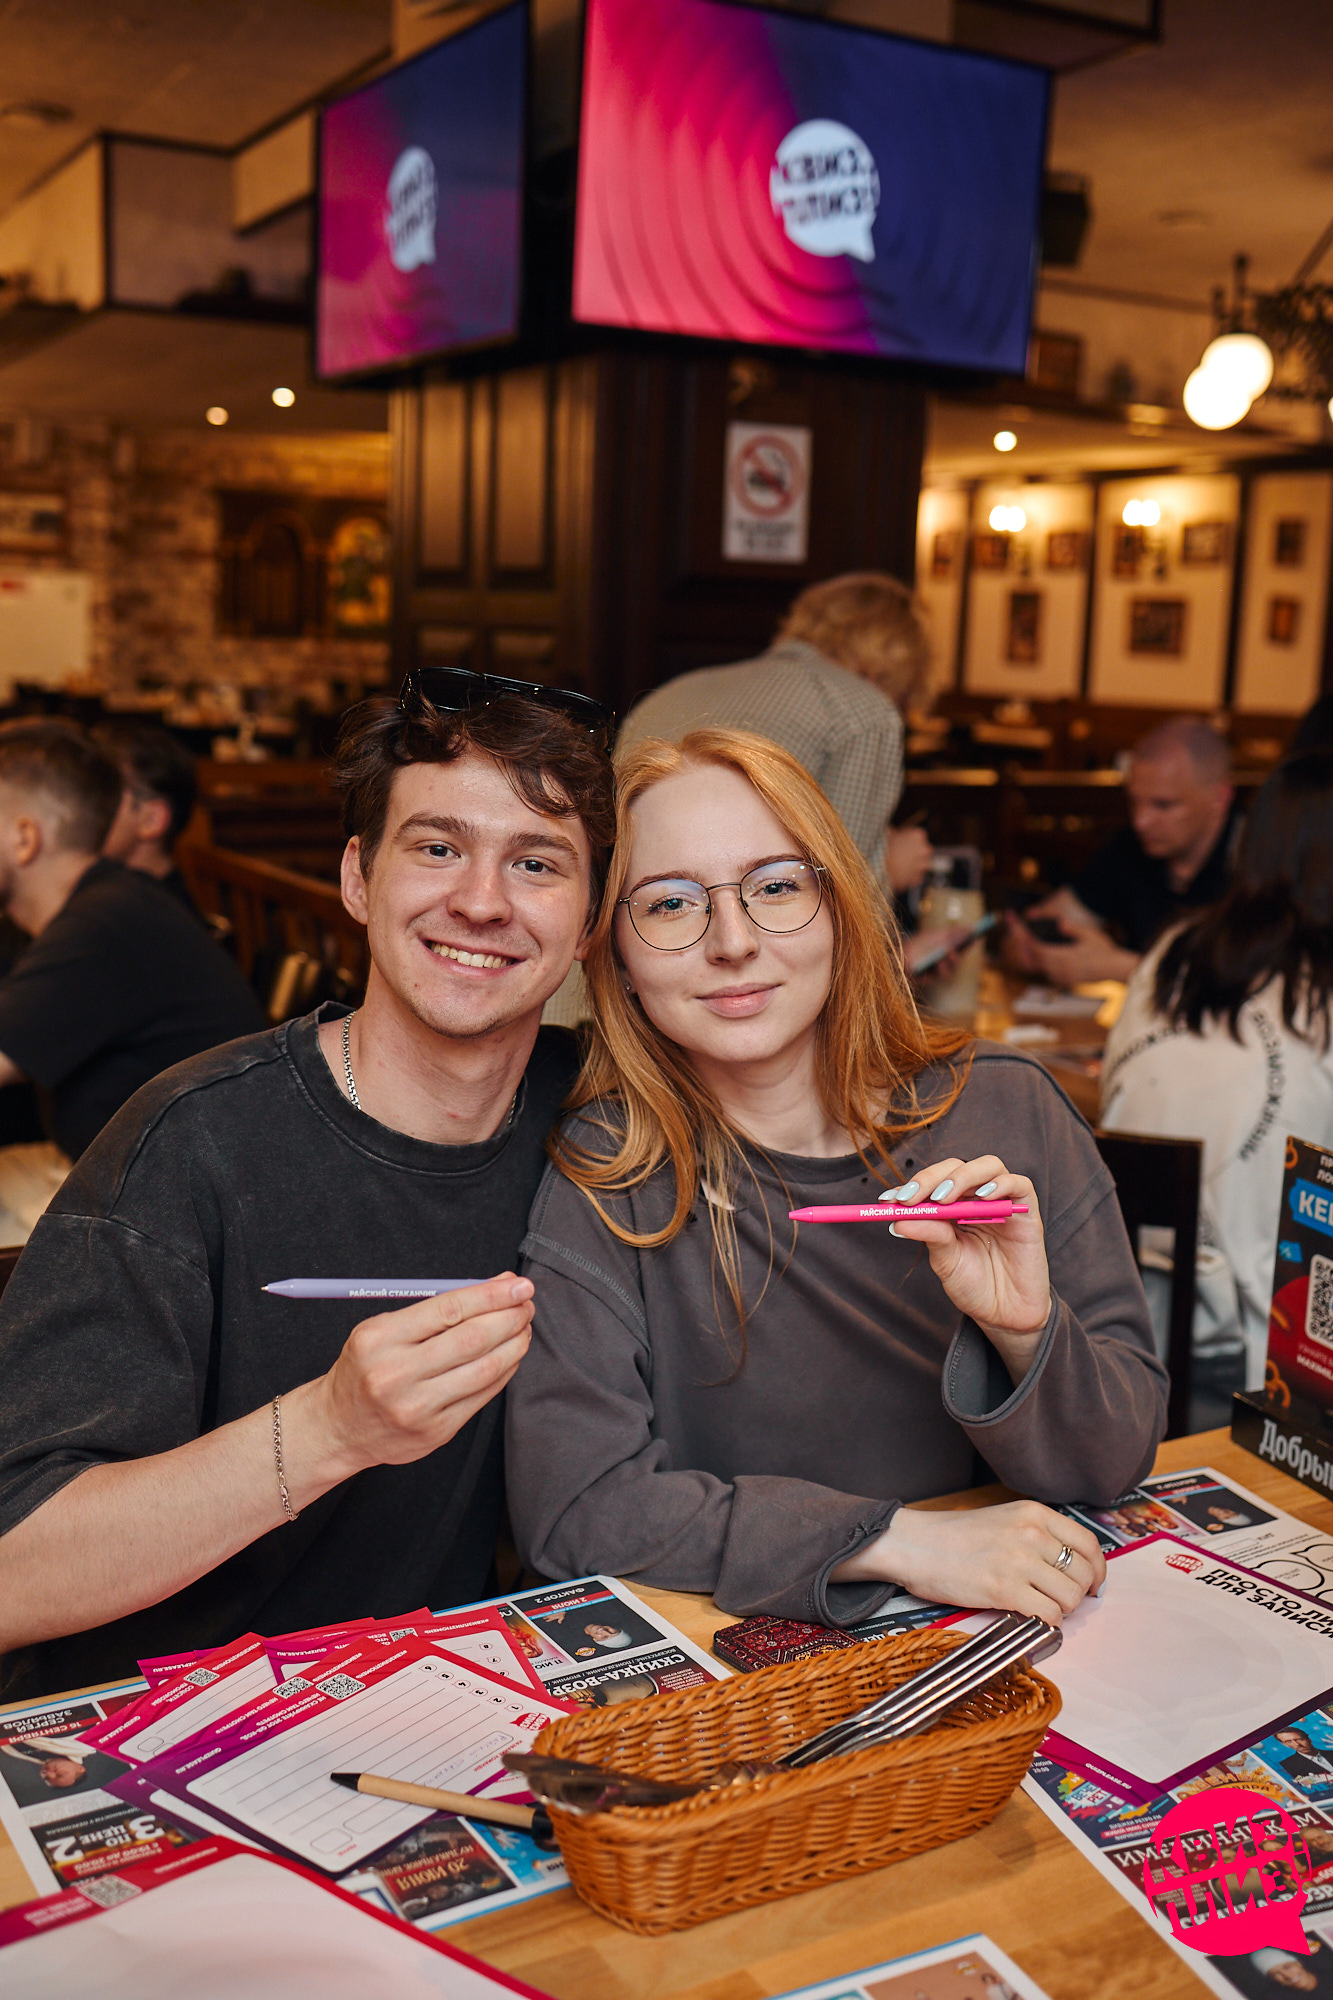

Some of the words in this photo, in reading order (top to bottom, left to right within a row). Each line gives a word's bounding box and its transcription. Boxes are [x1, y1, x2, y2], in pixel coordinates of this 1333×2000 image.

[860, 1207, 894, 1217] РАЙСКИЙ
[894, 1206, 938, 1216] СТАКАНЧИК
[349, 1288, 387, 1297] РАЙСКИЙ
[1258, 1418, 1333, 1491] Добры
[544, 1586, 585, 1602] ФАКТОР
[1210, 1568, 1302, 1610] ПРОСТО
[1195, 1574, 1248, 1596] ДЛЯ
[1246, 1593, 1333, 1639] ЗАПИСИ
[276, 1647, 327, 1657] QUIZPLEASE.RU
[3, 1709, 73, 1730] ЗАВЬЯЛОВ
[16, 1716, 65, 1734] СЕРГЕЙ
[8, 1725, 68, 1743] СЕНТЯБРЯ
[1085, 1763, 1132, 1790] QUIZPLEASE.RU
[79, 1824, 127, 1845] ЦЕНЕ
[128, 1814, 165, 1840] 3
[45, 1835, 84, 1863] 2
[105, 1833, 132, 1848] ПО
[447, 1857, 470, 1874] 20
[395, 1865, 445, 1891] ИЮНЯ
